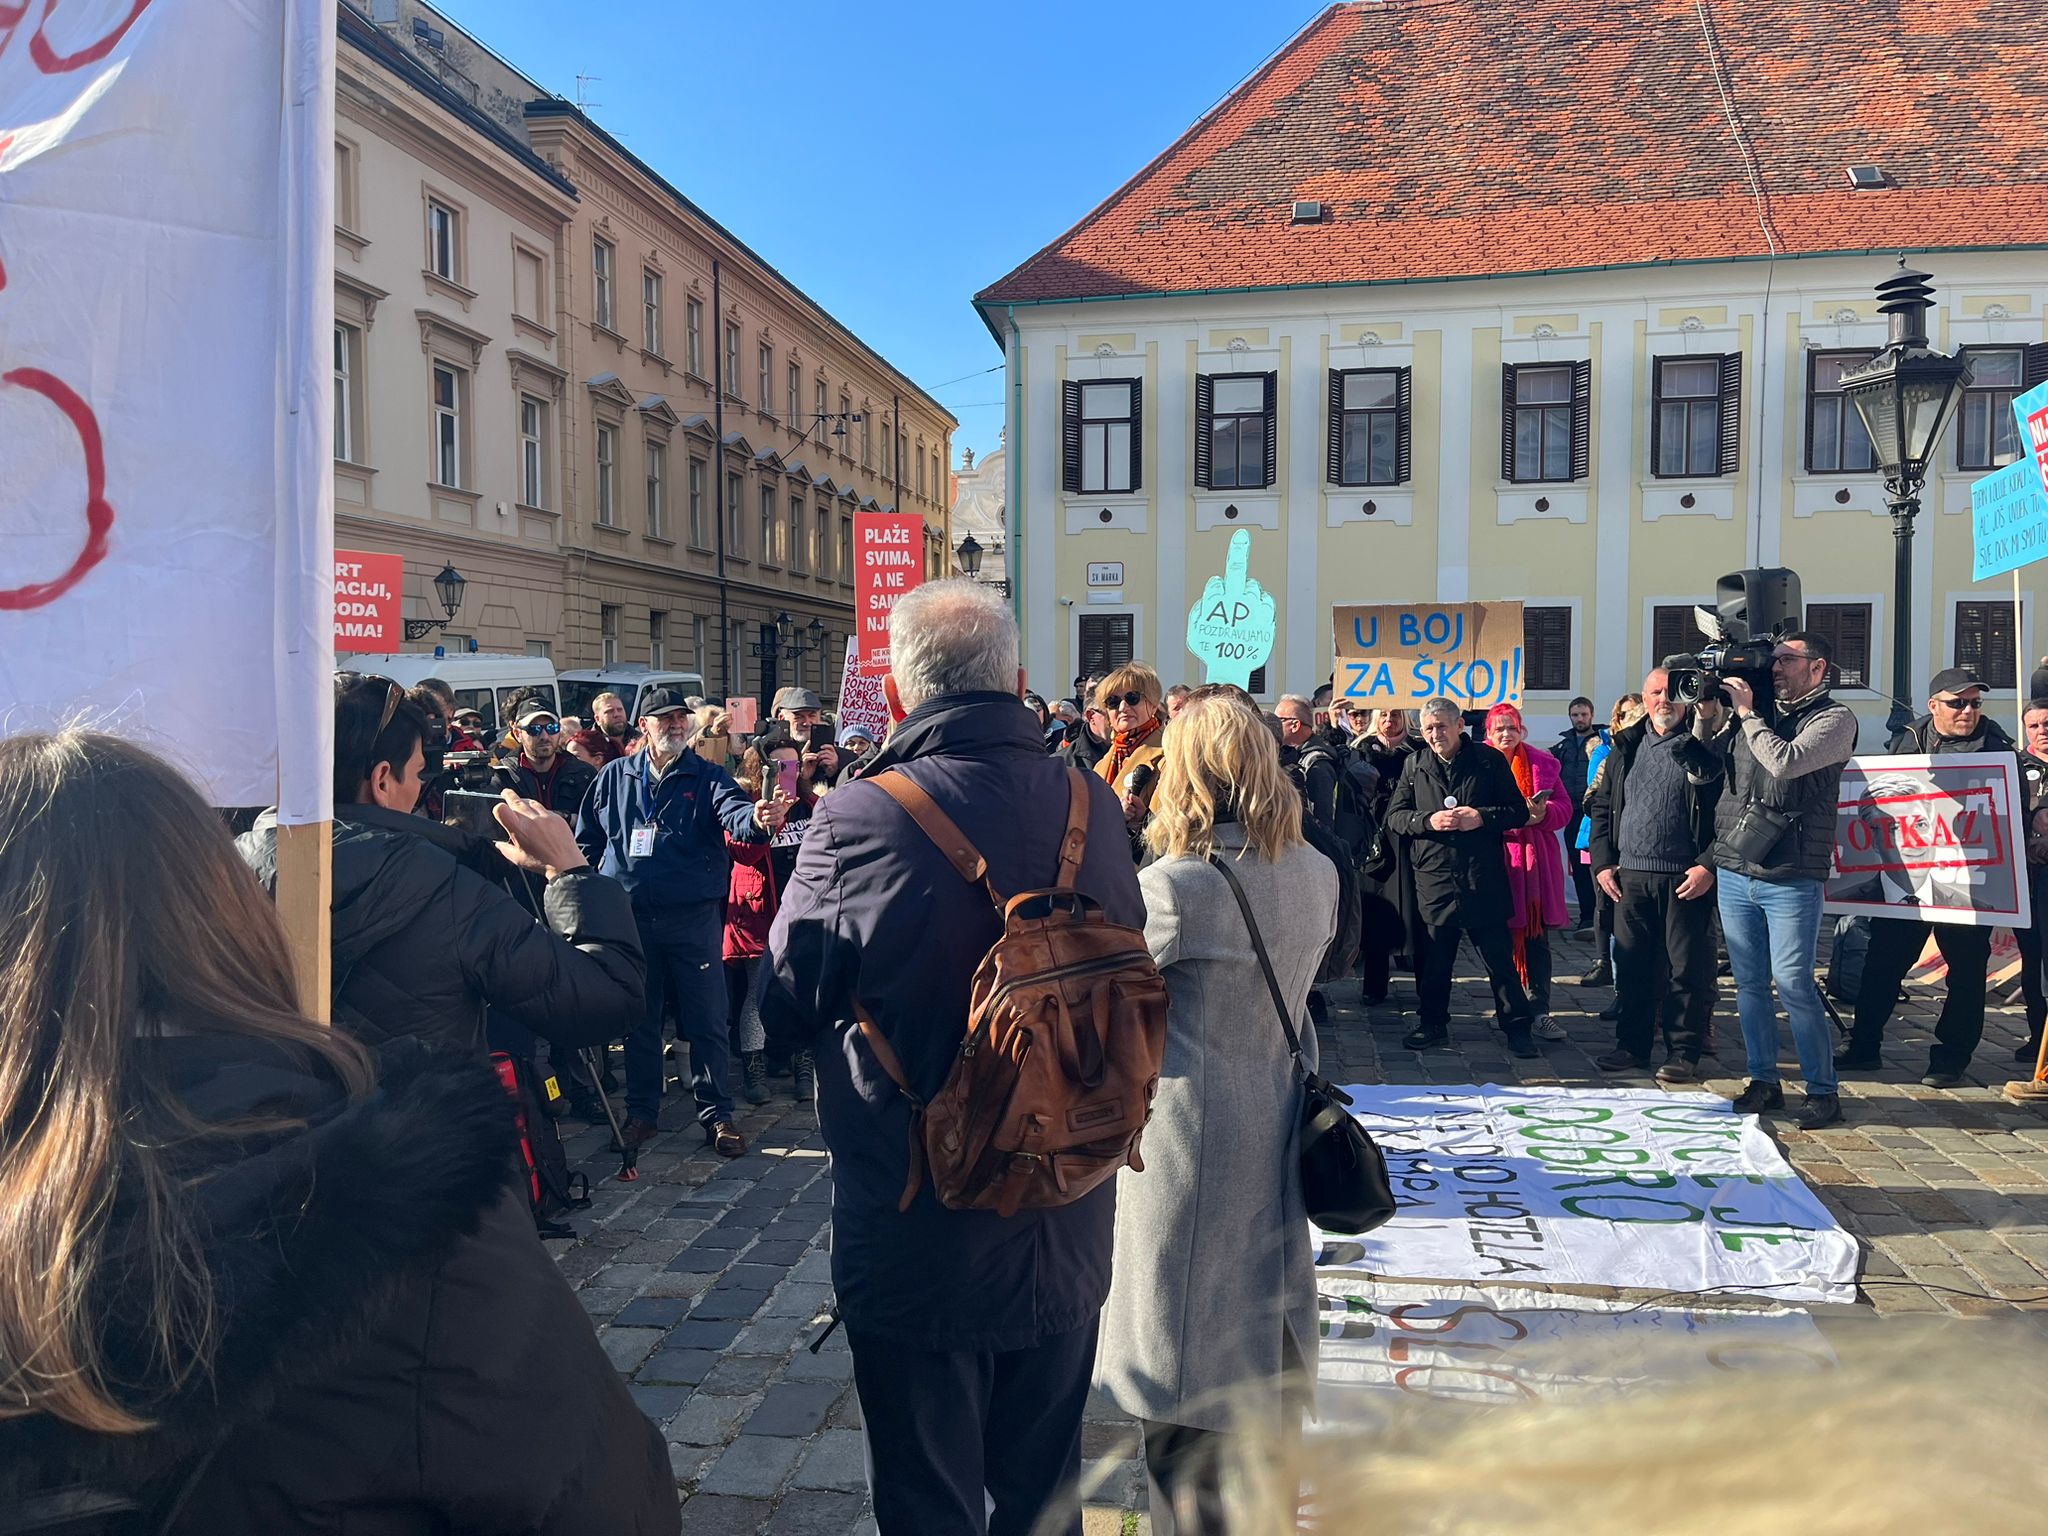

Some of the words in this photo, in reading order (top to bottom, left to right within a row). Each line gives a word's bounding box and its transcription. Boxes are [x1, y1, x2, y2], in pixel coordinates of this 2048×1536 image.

[865, 523, 910, 544] PLAŽE
[865, 550, 916, 569] SVIMA,
[873, 573, 883, 588] A
[886, 572, 905, 587] NE
[1101, 572, 1118, 582] MARKA
[869, 593, 905, 610] SAM
[1206, 600, 1250, 628] AP
[1354, 616, 1378, 648] U
[1400, 612, 1464, 654] BOJ
[1344, 663, 1395, 697] ZA
[1411, 646, 1522, 707] ŠKOJ!
[844, 687, 879, 701] DOBRO
[1847, 810, 1983, 852] OTKAZ
[1503, 1105, 1706, 1224] DOBRO
[1456, 1190, 1552, 1277] HOTELA
